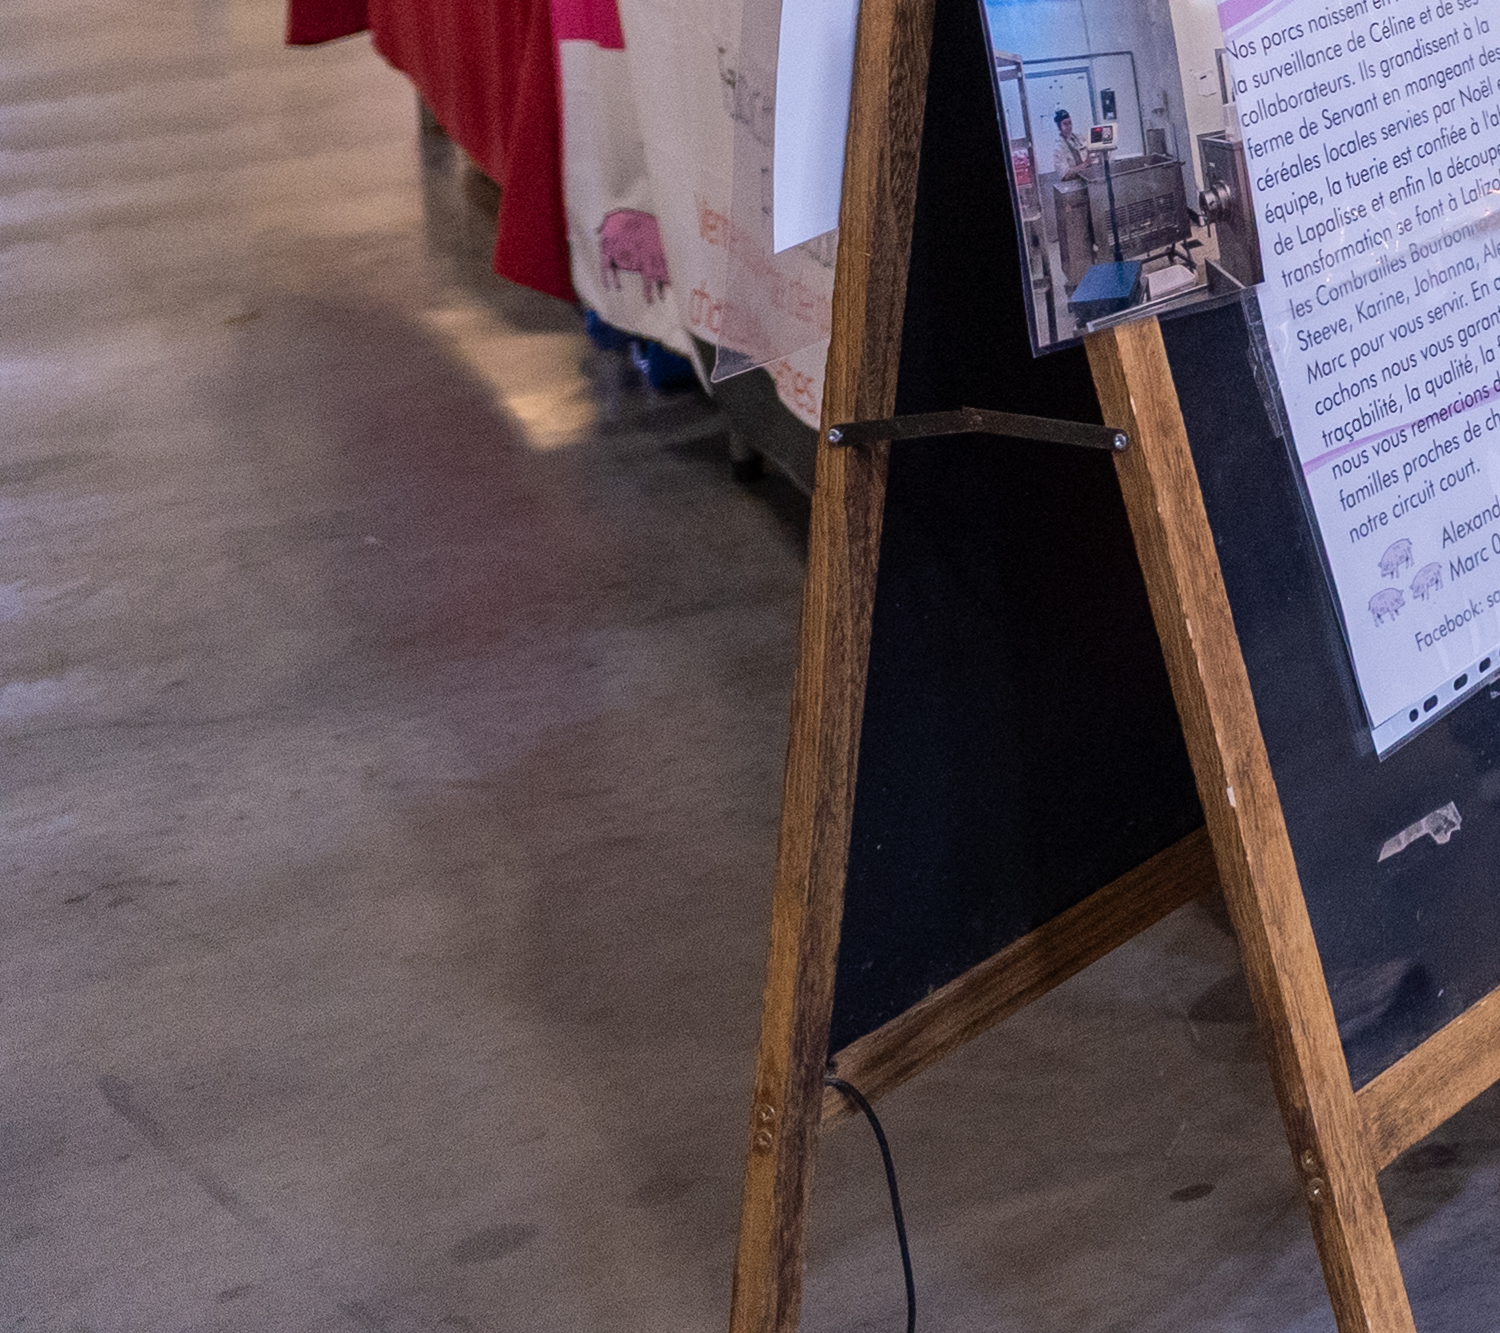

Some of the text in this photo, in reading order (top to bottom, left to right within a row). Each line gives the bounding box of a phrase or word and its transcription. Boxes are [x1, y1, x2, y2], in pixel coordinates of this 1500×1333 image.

[1264, 190, 1323, 223] équipe,
[1325, 176, 1342, 196] la
[1345, 157, 1388, 188] tuerie
[1392, 146, 1412, 168] est
[1416, 124, 1467, 158] confiée
[1470, 116, 1480, 135] à
[1449, 547, 1488, 580] Marc
[1414, 599, 1483, 651] Facebook:
